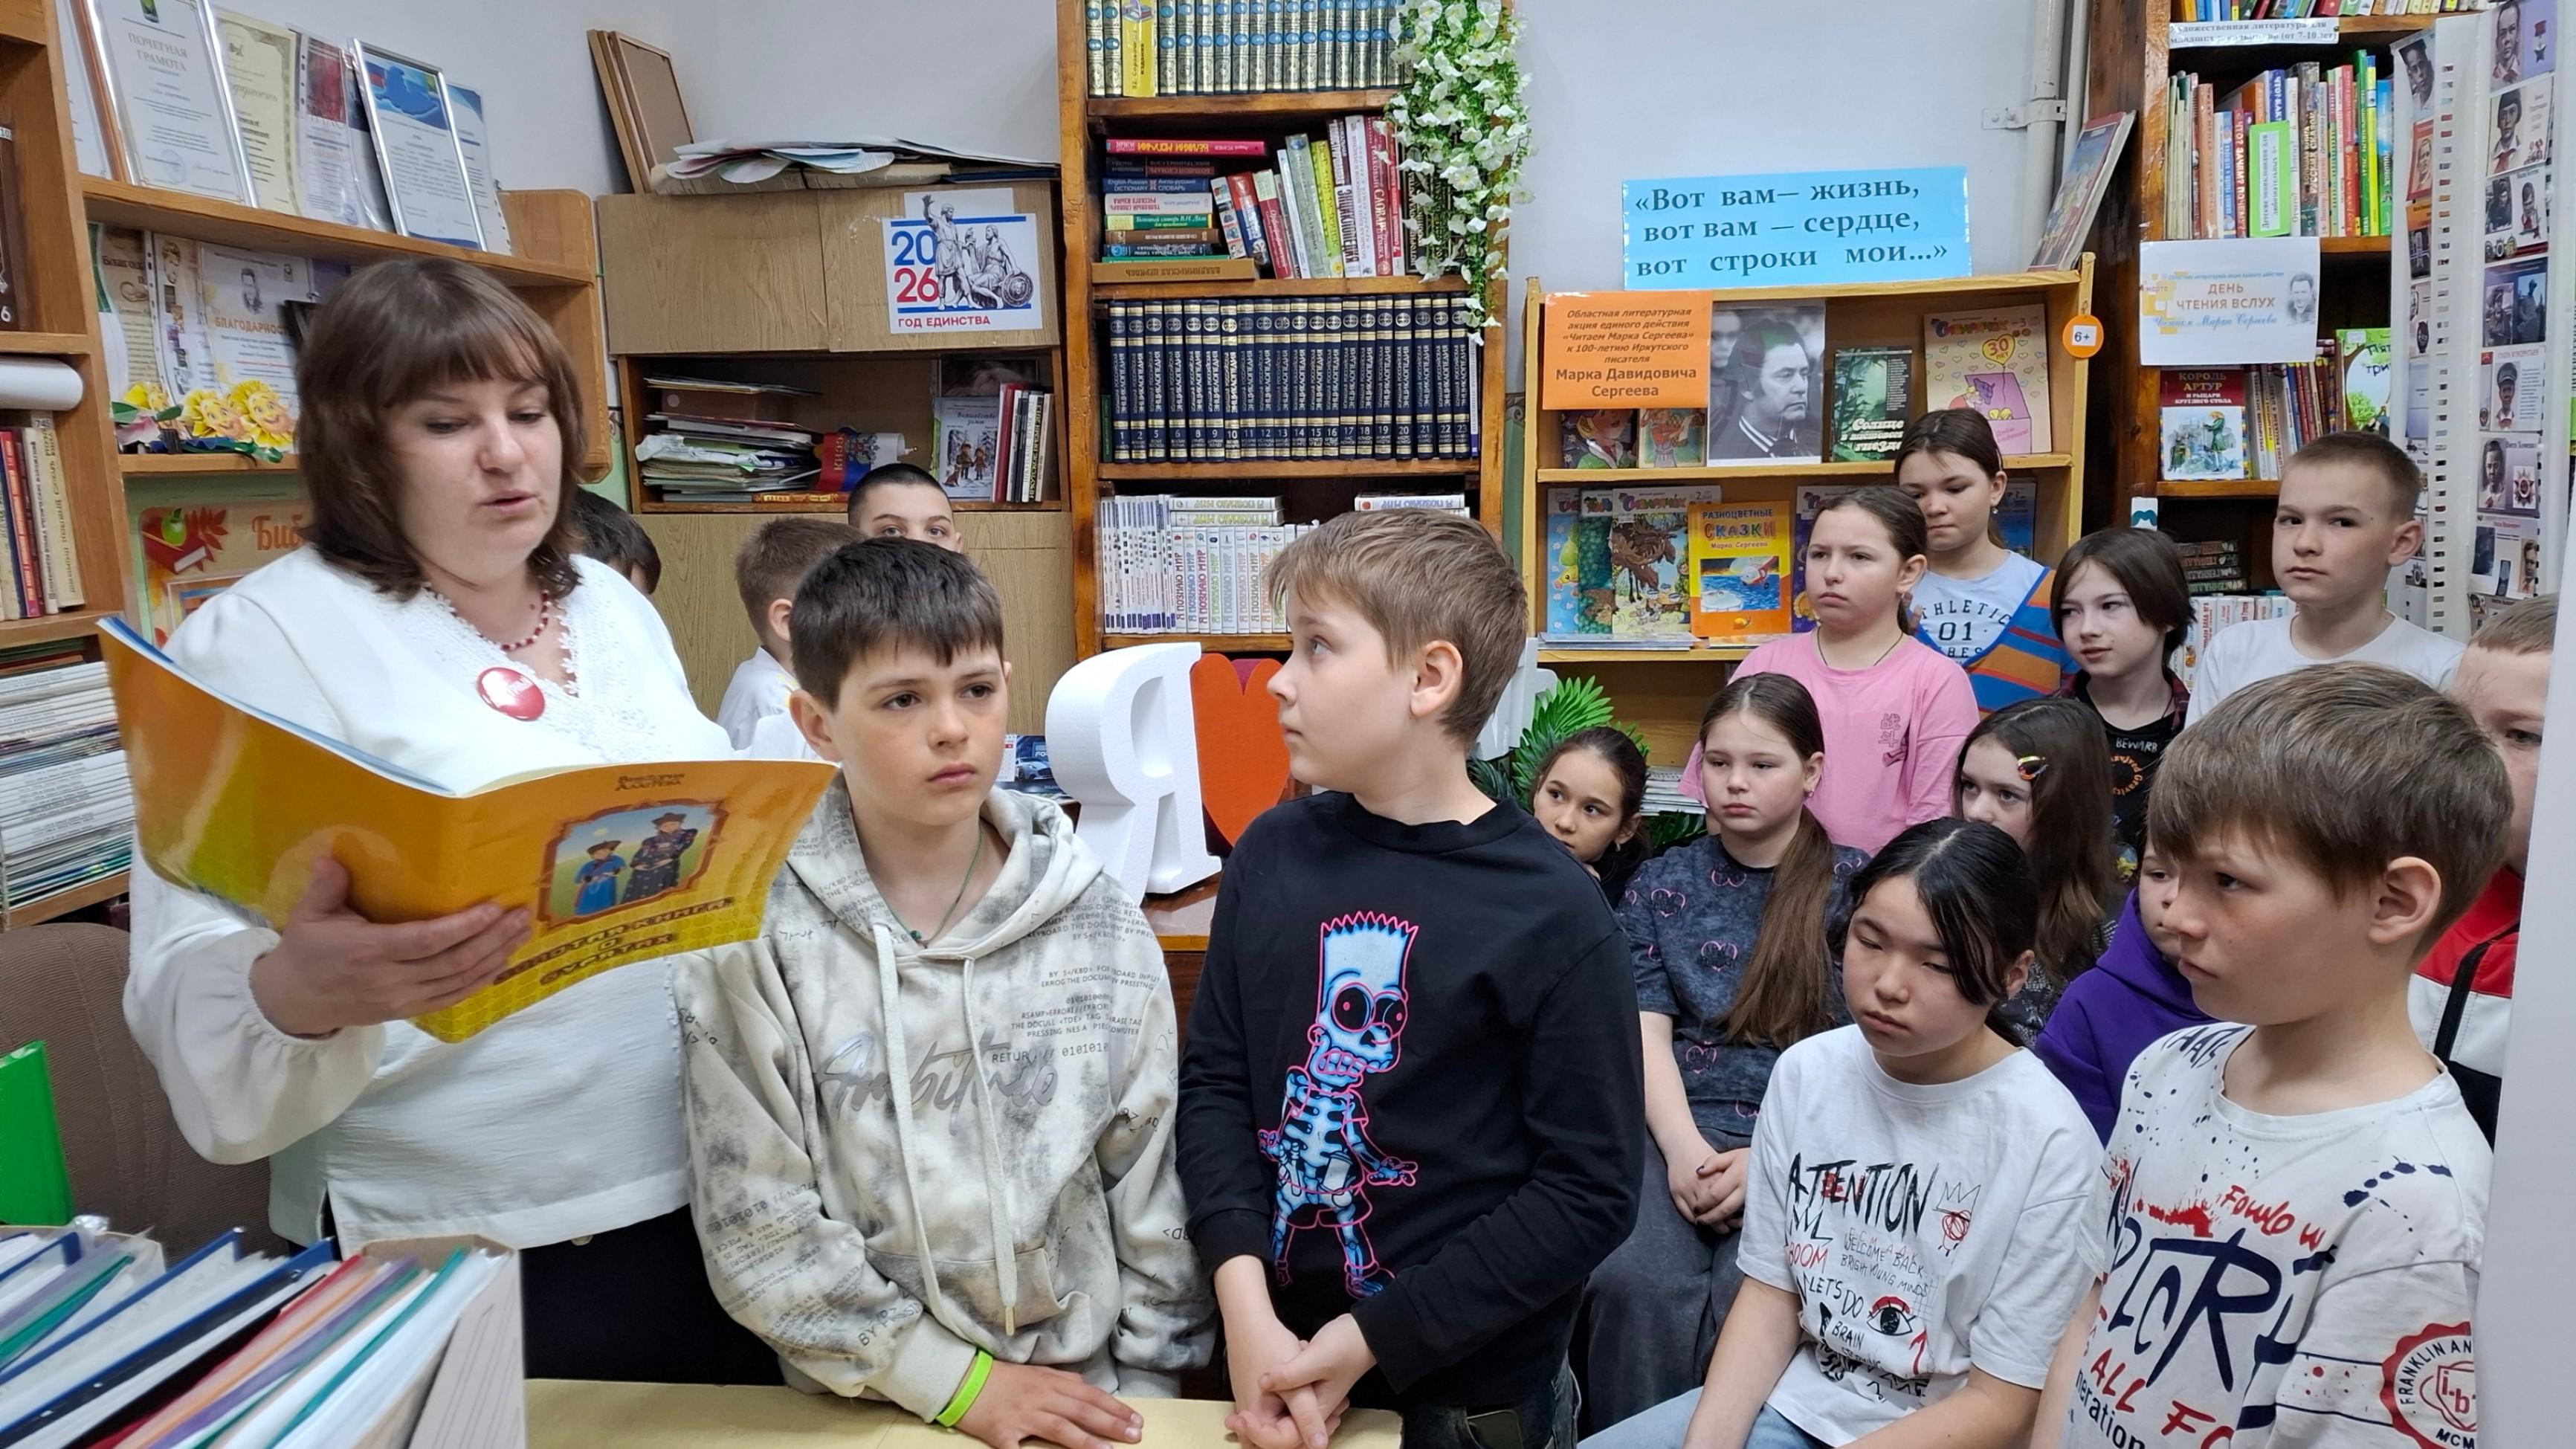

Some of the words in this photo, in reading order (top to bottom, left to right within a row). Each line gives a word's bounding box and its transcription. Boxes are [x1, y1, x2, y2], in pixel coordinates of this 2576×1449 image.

[137, 50, 187, 72] ГРАМОТА
[1636, 188, 1705, 213] «Вот
[1810, 179, 1920, 201] жизнь,
[1373, 189, 1387, 232] СЛОВАРЬ
[1337, 189, 1360, 263] ЭНЦИКЛОПЕДИЯ
[1643, 223, 1694, 242] вот
[1703, 219, 1758, 239] вам
[1804, 211, 1920, 238] сердце,
[891, 230, 937, 266] 20
[103, 256, 146, 270] Благод
[1636, 258, 1688, 277] вот
[1710, 250, 1817, 277] строки
[894, 267, 940, 303] 26
[2208, 284, 2244, 295] ДЕНЬ
[2177, 299, 2227, 309] ЧТЕНИЯ
[2232, 297, 2275, 309] ВСЛУХ
[1567, 309, 1620, 318] Областная
[1623, 308, 1691, 318] литературная
[215, 317, 286, 335] БЛАГОДАРНОС
[898, 317, 922, 328] ГОД
[927, 315, 990, 326] ЕДИНСТВА
[1567, 321, 1598, 330] акция
[1600, 320, 1641, 329] единого
[1643, 320, 1689, 329] действия
[1563, 333, 1604, 341] «Читаем
[1607, 332, 1639, 341] Марка
[1642, 331, 1694, 342] Сергеева»
[2074, 331, 2090, 342] 6+
[1575, 343, 1630, 353] 100-летию
[1632, 343, 1689, 353] Иркутского
[1987, 338, 2009, 356] 30
[2366, 343, 2391, 355] Пят
[1604, 355, 1650, 364] писателя
[1555, 369, 1601, 382] Марка
[1606, 367, 1697, 382] Давидовича
[2179, 372, 2227, 382] КОРОЛЬ
[1195, 351, 1204, 412] ЭНЦИКЛОПЕДИЯ
[1230, 352, 1238, 413] ЭНЦИКЛОПЕДИЯ
[2183, 382, 2223, 391] АРТУР
[1592, 385, 1659, 399] Сергеева
[1155, 430, 1159, 438] 5
[1175, 430, 1181, 438] 6
[1195, 430, 1201, 438] 8
[1213, 429, 1218, 438] 9
[1227, 430, 1238, 439] 10
[1262, 429, 1271, 437] 12
[1278, 429, 1288, 437] 13
[1294, 428, 1305, 437] 14
[1311, 428, 1321, 436] 15
[1327, 427, 1337, 436] 16
[1344, 427, 1354, 435] 17
[1360, 427, 1370, 435] 18
[1378, 425, 1389, 434] 19
[1398, 425, 1409, 435] 20
[1420, 425, 1430, 433] 21
[1440, 425, 1450, 433] 22
[1456, 424, 1468, 433] 23
[1702, 509, 1773, 519] РАЗНОЦВЕТНЫЕ
[1703, 521, 1776, 540] СКАЗКИ
[1175, 552, 1184, 572] МИР
[1197, 549, 1207, 571] МИР
[1176, 574, 1184, 610] ПОЗНАЮ
[1198, 573, 1207, 614] ПОЗНАЮ
[1176, 611, 1185, 620] Я
[1922, 599, 2012, 625] THLETIC
[1938, 622, 1972, 641] 01
[1045, 642, 1222, 909] Я
[1042, 978, 1065, 987] ERROG
[1011, 1019, 1024, 1029] THE
[1786, 1152, 1940, 1242] ATTENTION
[1789, 1242, 1829, 1273] BOOM
[1844, 1233, 1885, 1261] WELCOME
[1893, 1252, 1924, 1278] BACK
[1841, 1254, 1868, 1277] BRIGHT
[1870, 1263, 1897, 1285] YOUNG
[1897, 1280, 1928, 1297] MINDS
[1809, 1277, 1844, 1300] LET'S
[1841, 1295, 1863, 1319] DO
[1831, 1320, 1865, 1350] BRAIN
[2398, 1342, 2446, 1405] FRANKLIN
[2090, 1348, 2146, 1413] ALL
